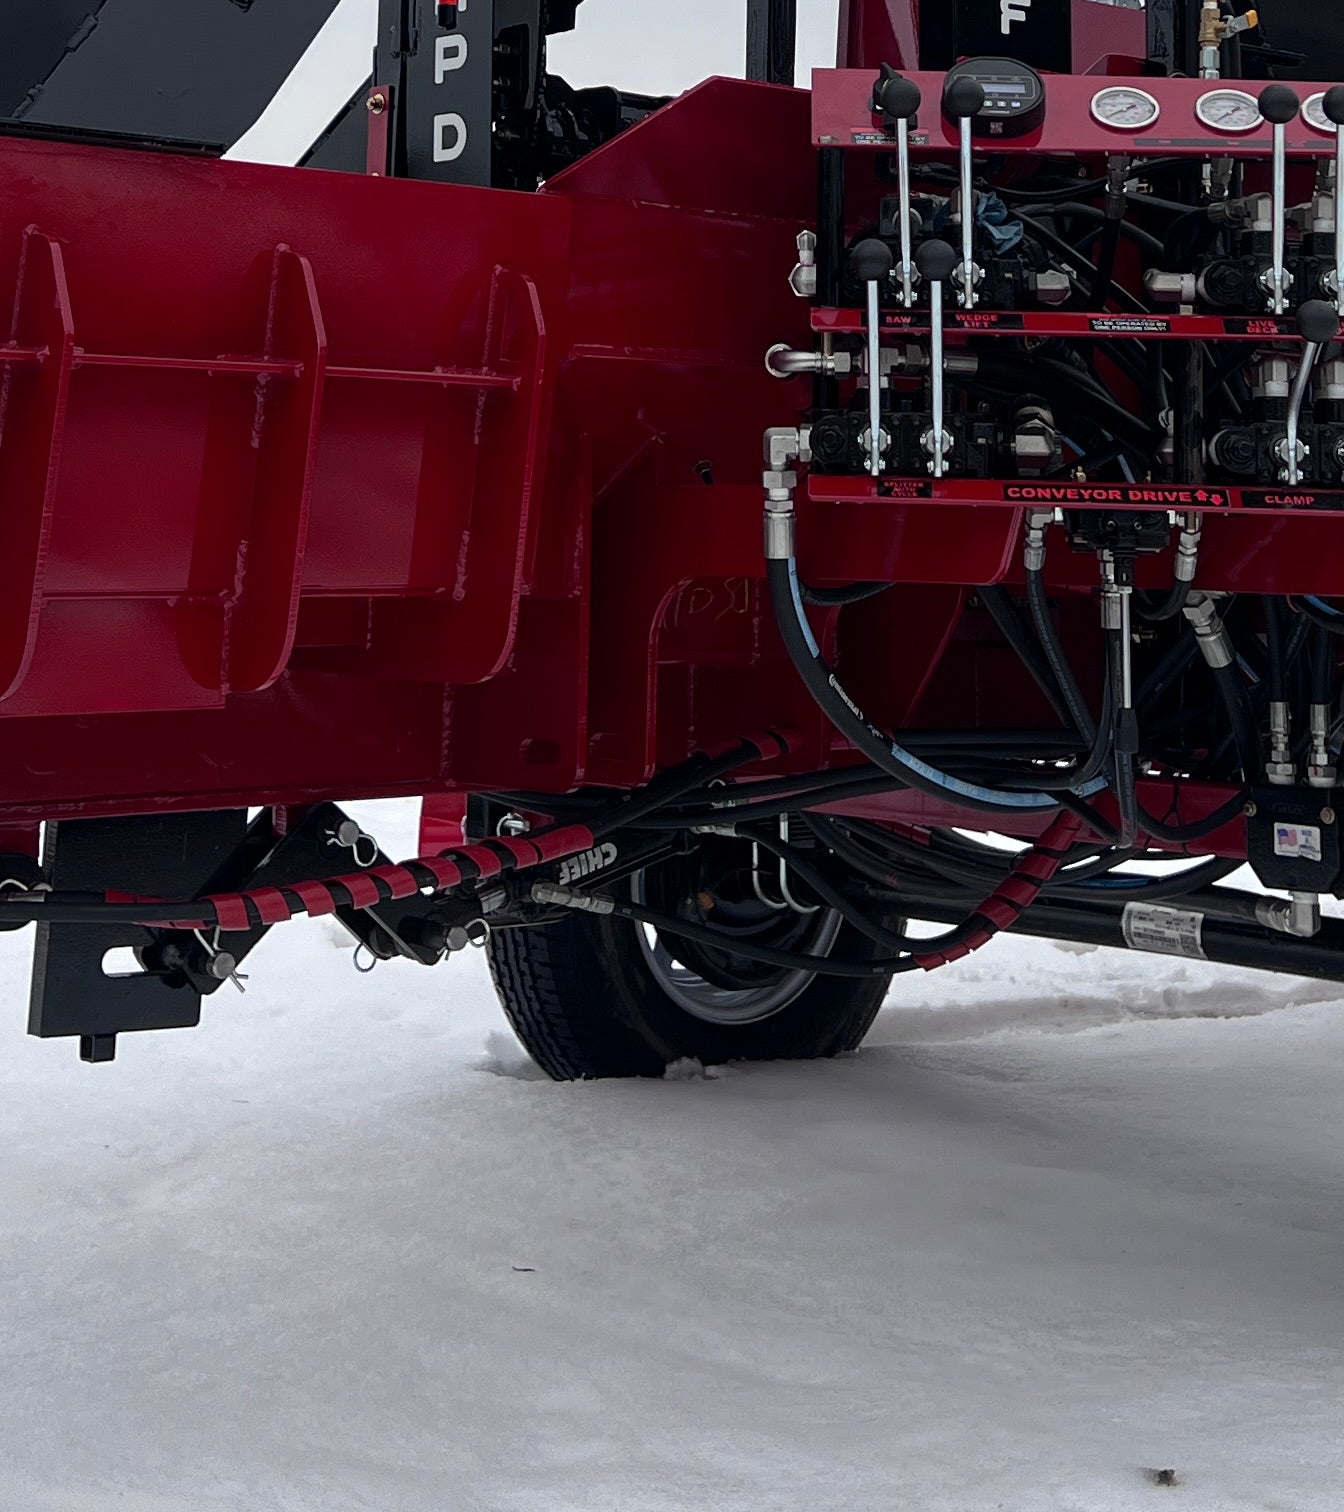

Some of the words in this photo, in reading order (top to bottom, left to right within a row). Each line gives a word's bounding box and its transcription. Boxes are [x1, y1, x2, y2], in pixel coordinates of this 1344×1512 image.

[1247, 326, 1279, 334] DECK
[1007, 487, 1122, 500] CONVEYOR
[1128, 490, 1192, 502] DRIVE
[1264, 495, 1316, 506] CLAMP
[559, 842, 618, 886] CHIEF
